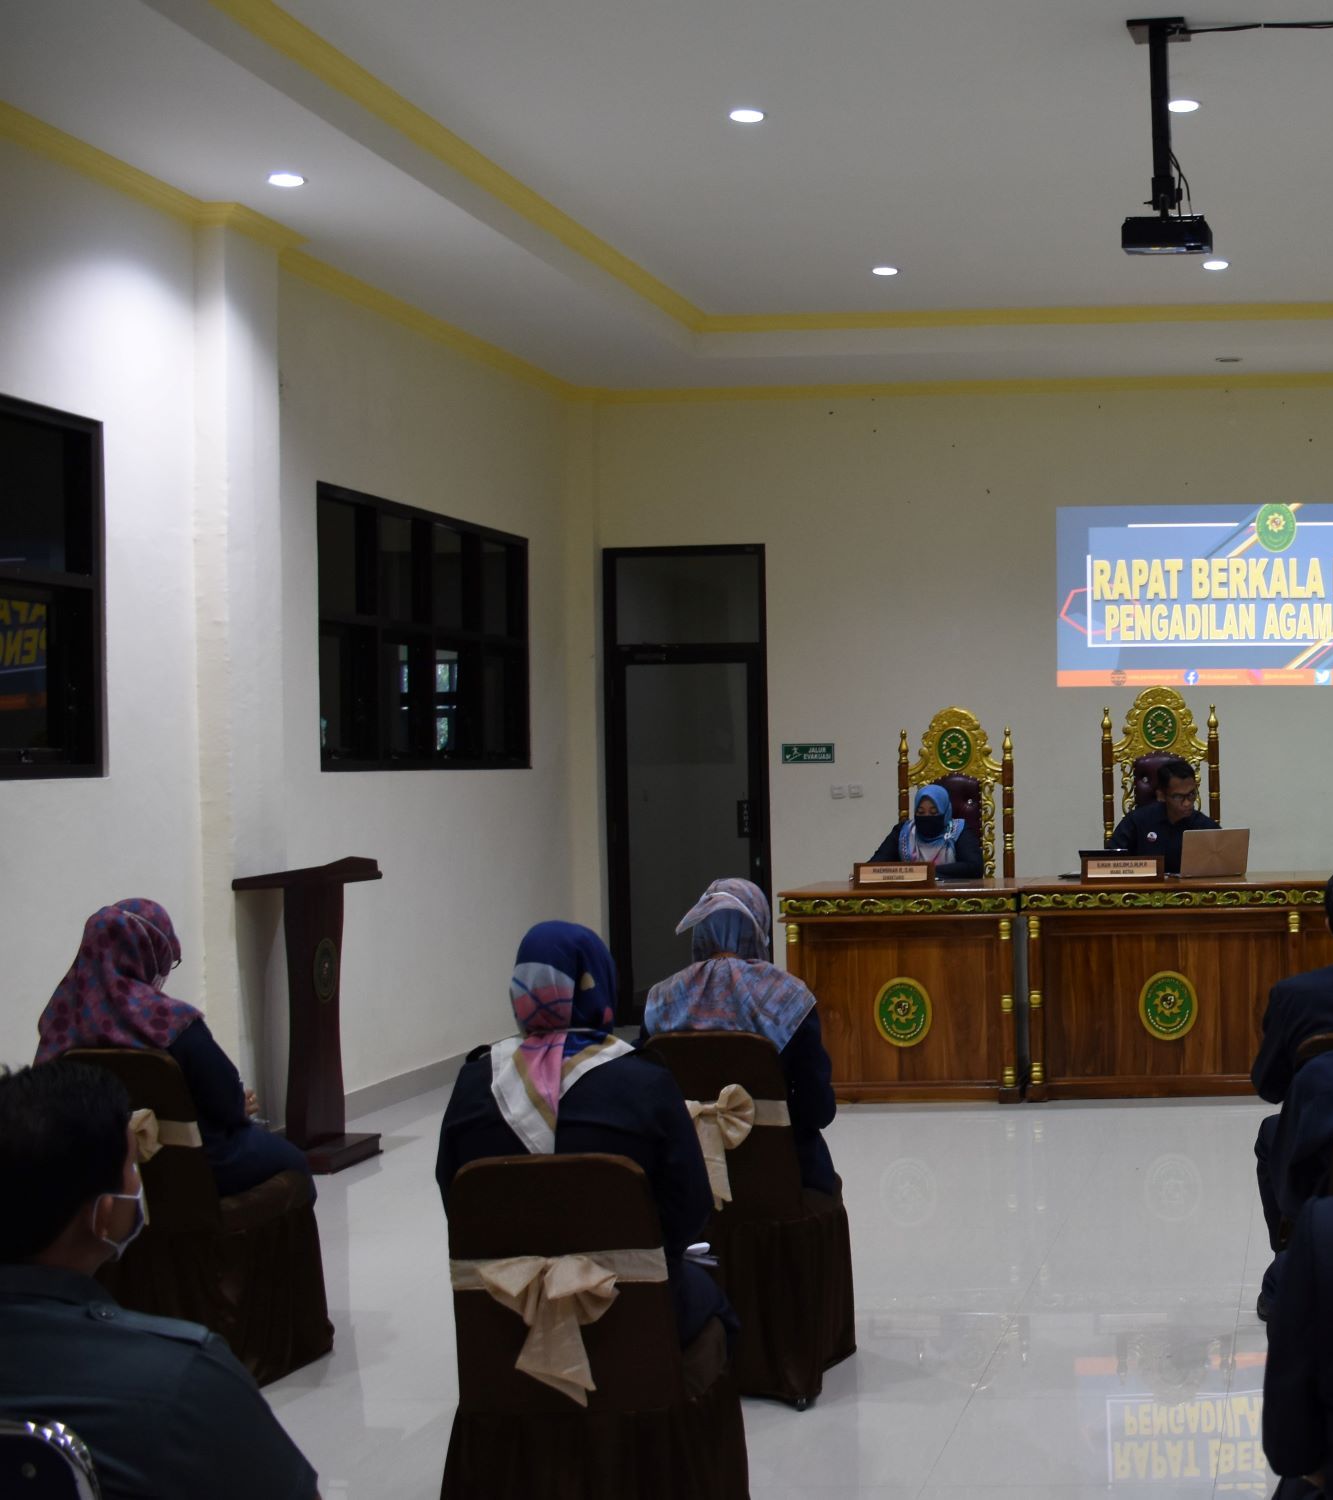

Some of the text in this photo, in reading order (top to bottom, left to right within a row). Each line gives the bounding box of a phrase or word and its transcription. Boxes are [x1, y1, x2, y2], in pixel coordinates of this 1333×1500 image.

[1093, 559, 1183, 600] RAPAT
[1191, 558, 1326, 599] BERKALA
[1105, 604, 1256, 641] PENGADILAN
